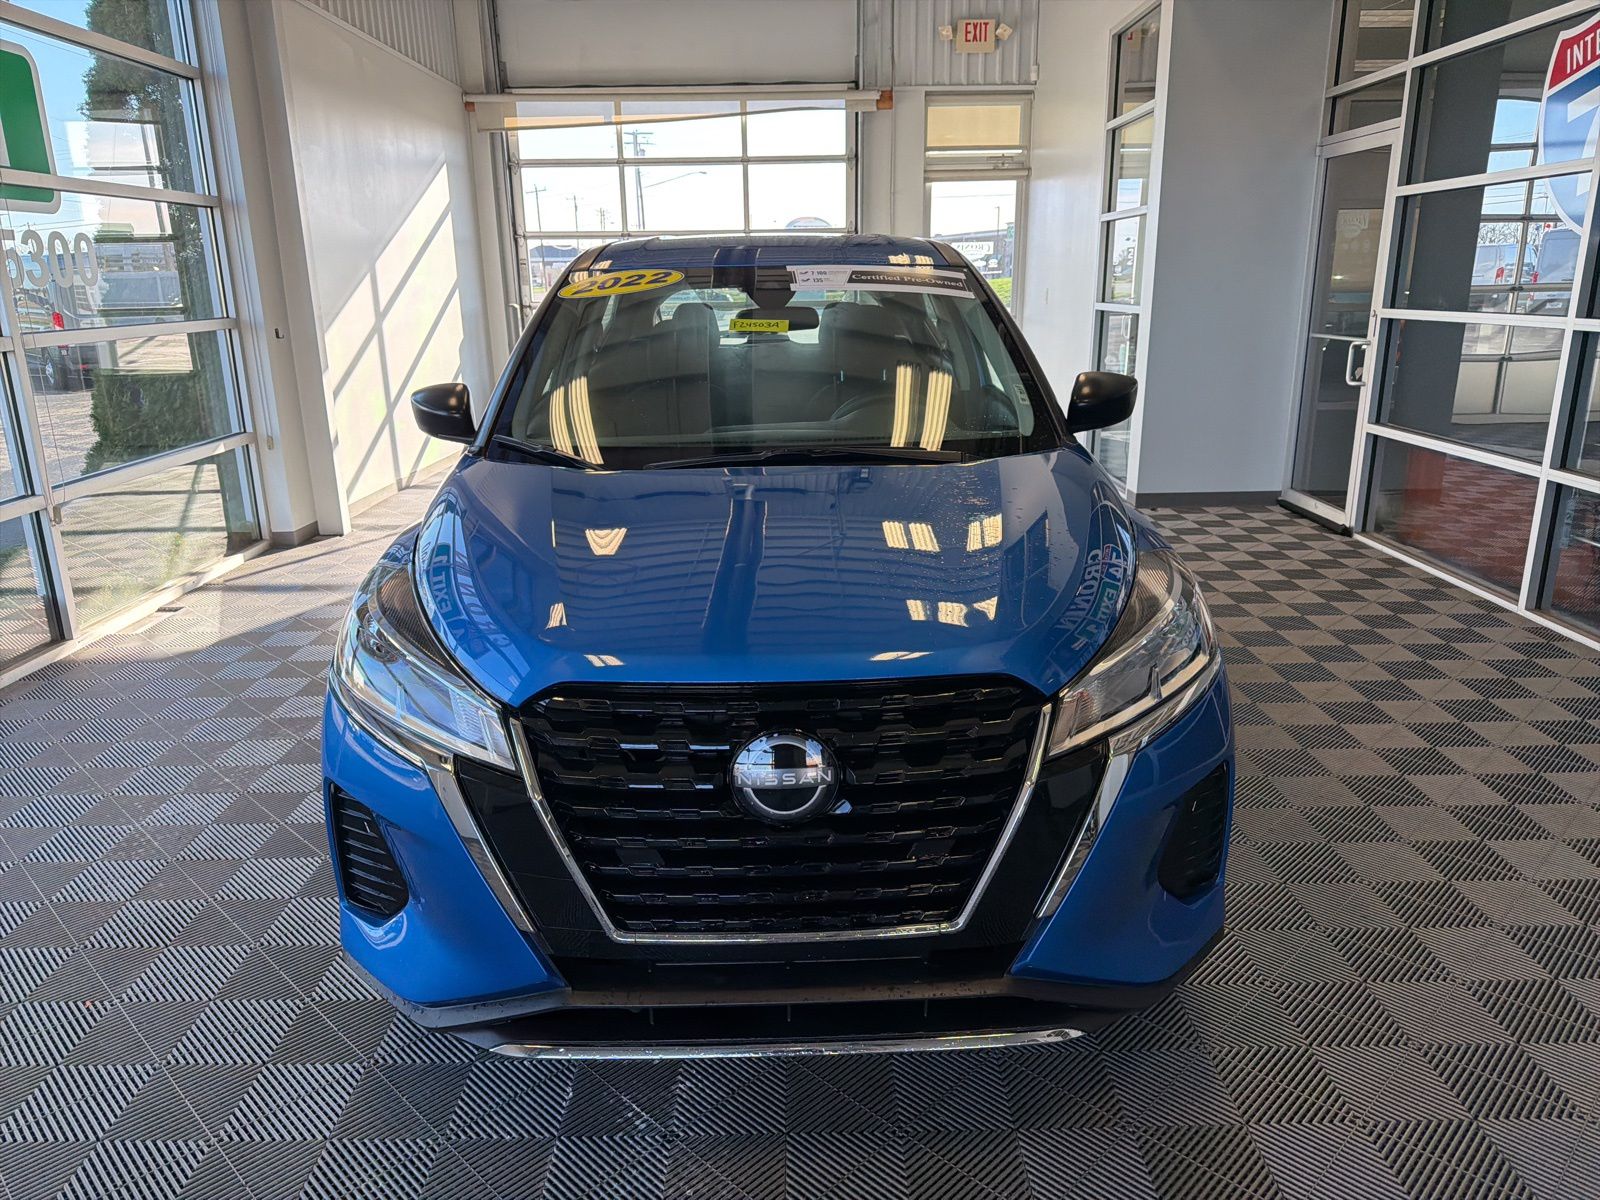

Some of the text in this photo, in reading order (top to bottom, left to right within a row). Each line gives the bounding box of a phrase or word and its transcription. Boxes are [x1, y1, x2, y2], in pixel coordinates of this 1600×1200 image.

[964, 22, 989, 43] EXIT
[570, 271, 675, 296] 2022
[851, 273, 901, 282] Certified
[903, 275, 964, 288] Pre-Owned
[737, 769, 832, 786] NISSAN
